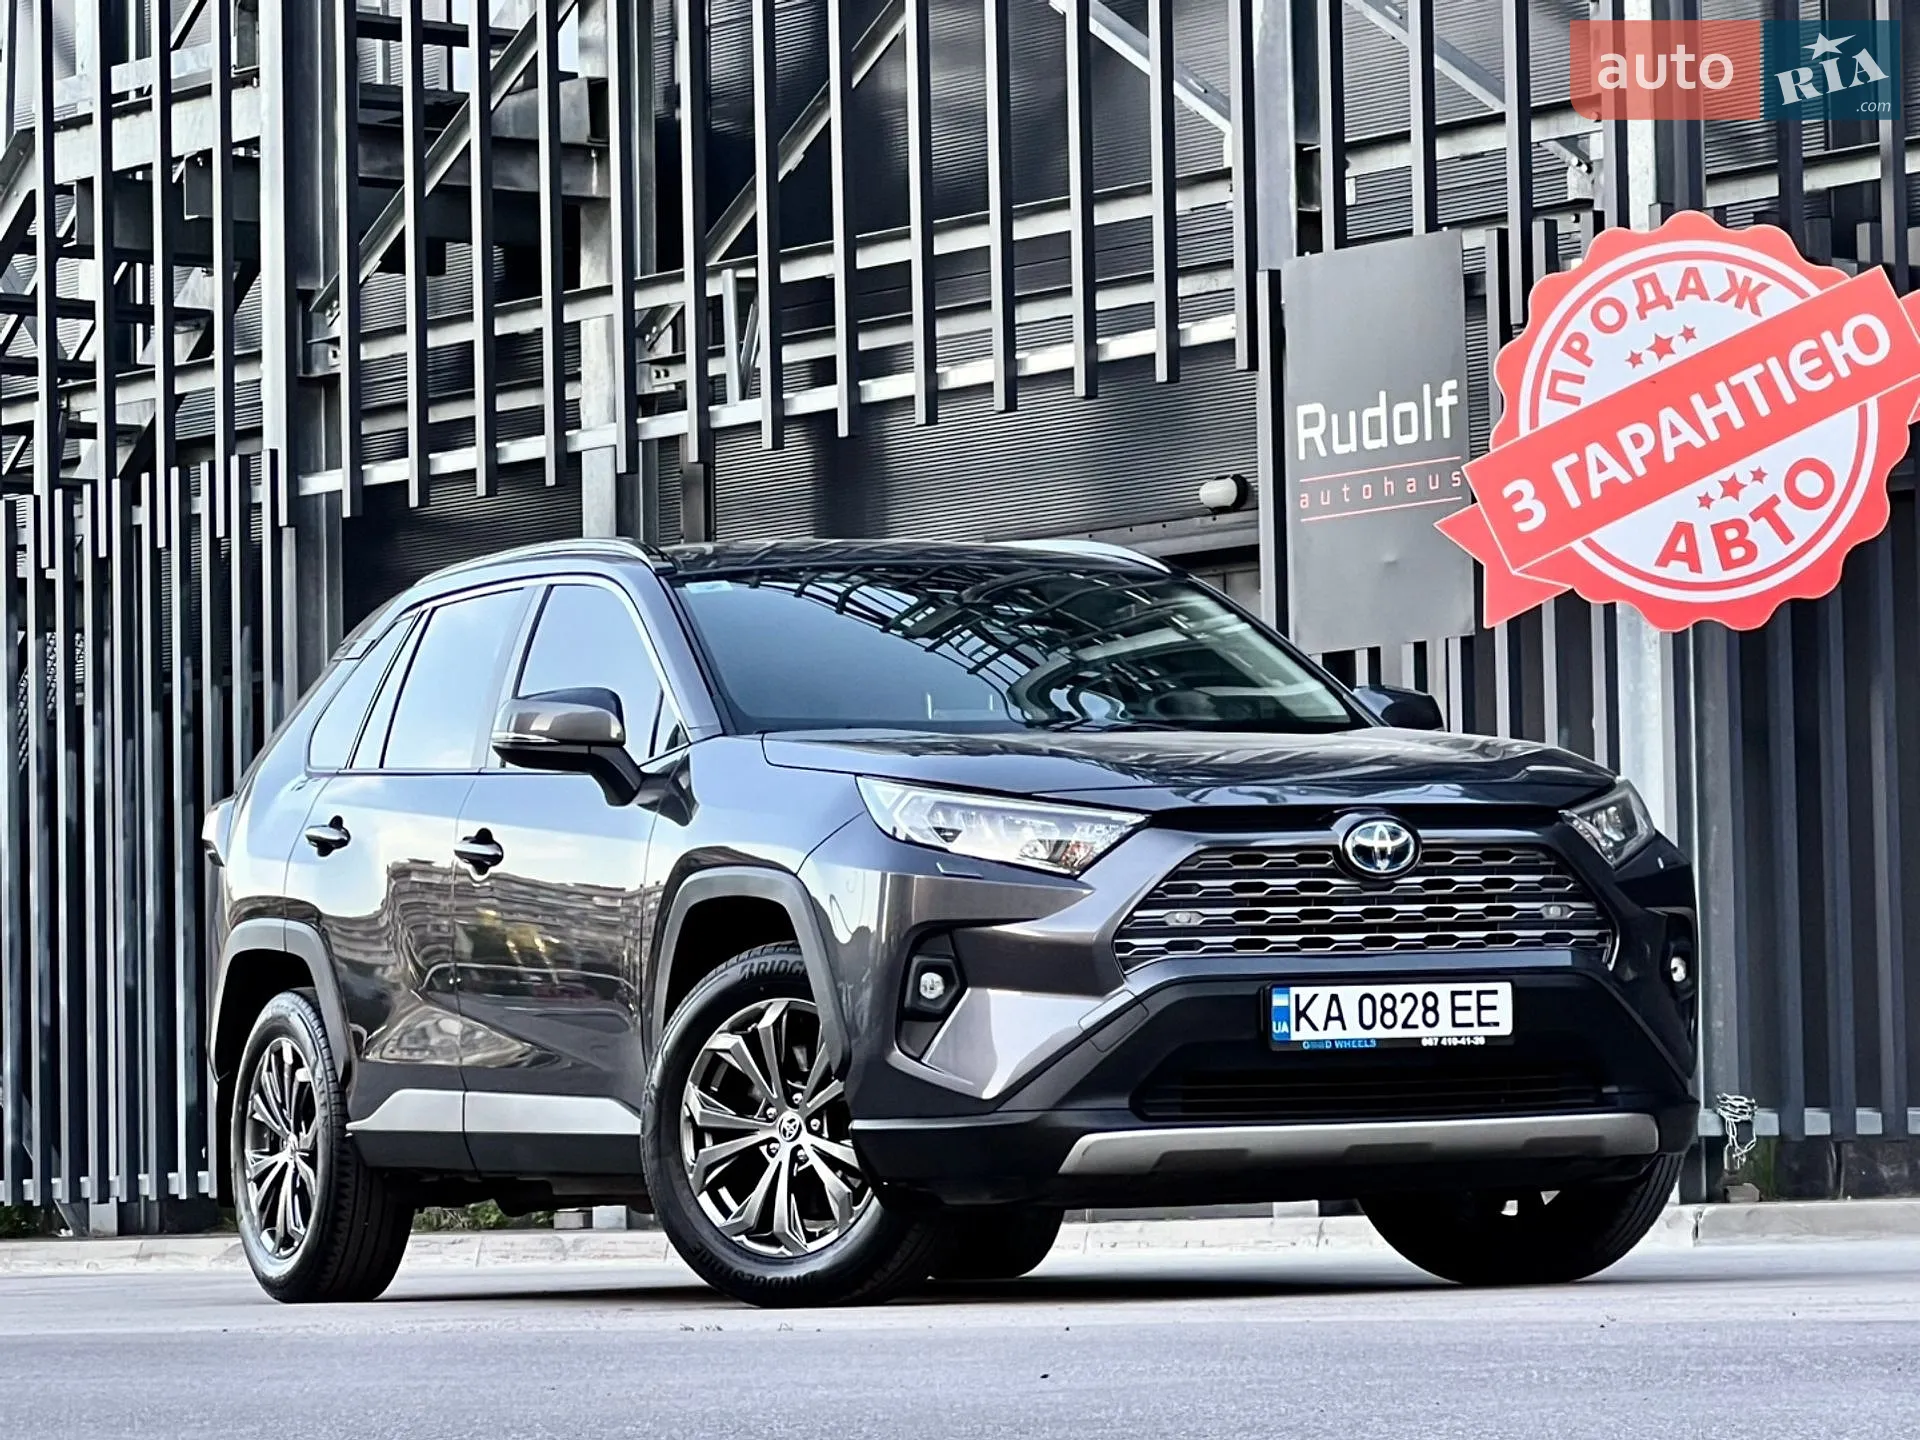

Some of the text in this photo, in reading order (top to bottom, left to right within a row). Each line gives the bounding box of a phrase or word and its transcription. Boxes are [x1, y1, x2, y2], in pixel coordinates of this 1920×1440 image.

[1296, 379, 1458, 460] Rudolf
[1300, 470, 1461, 509] autohaus
[1272, 1021, 1289, 1033] UA
[1294, 989, 1500, 1032] KA 0828 EE
[1334, 1039, 1377, 1049] WHEELS
